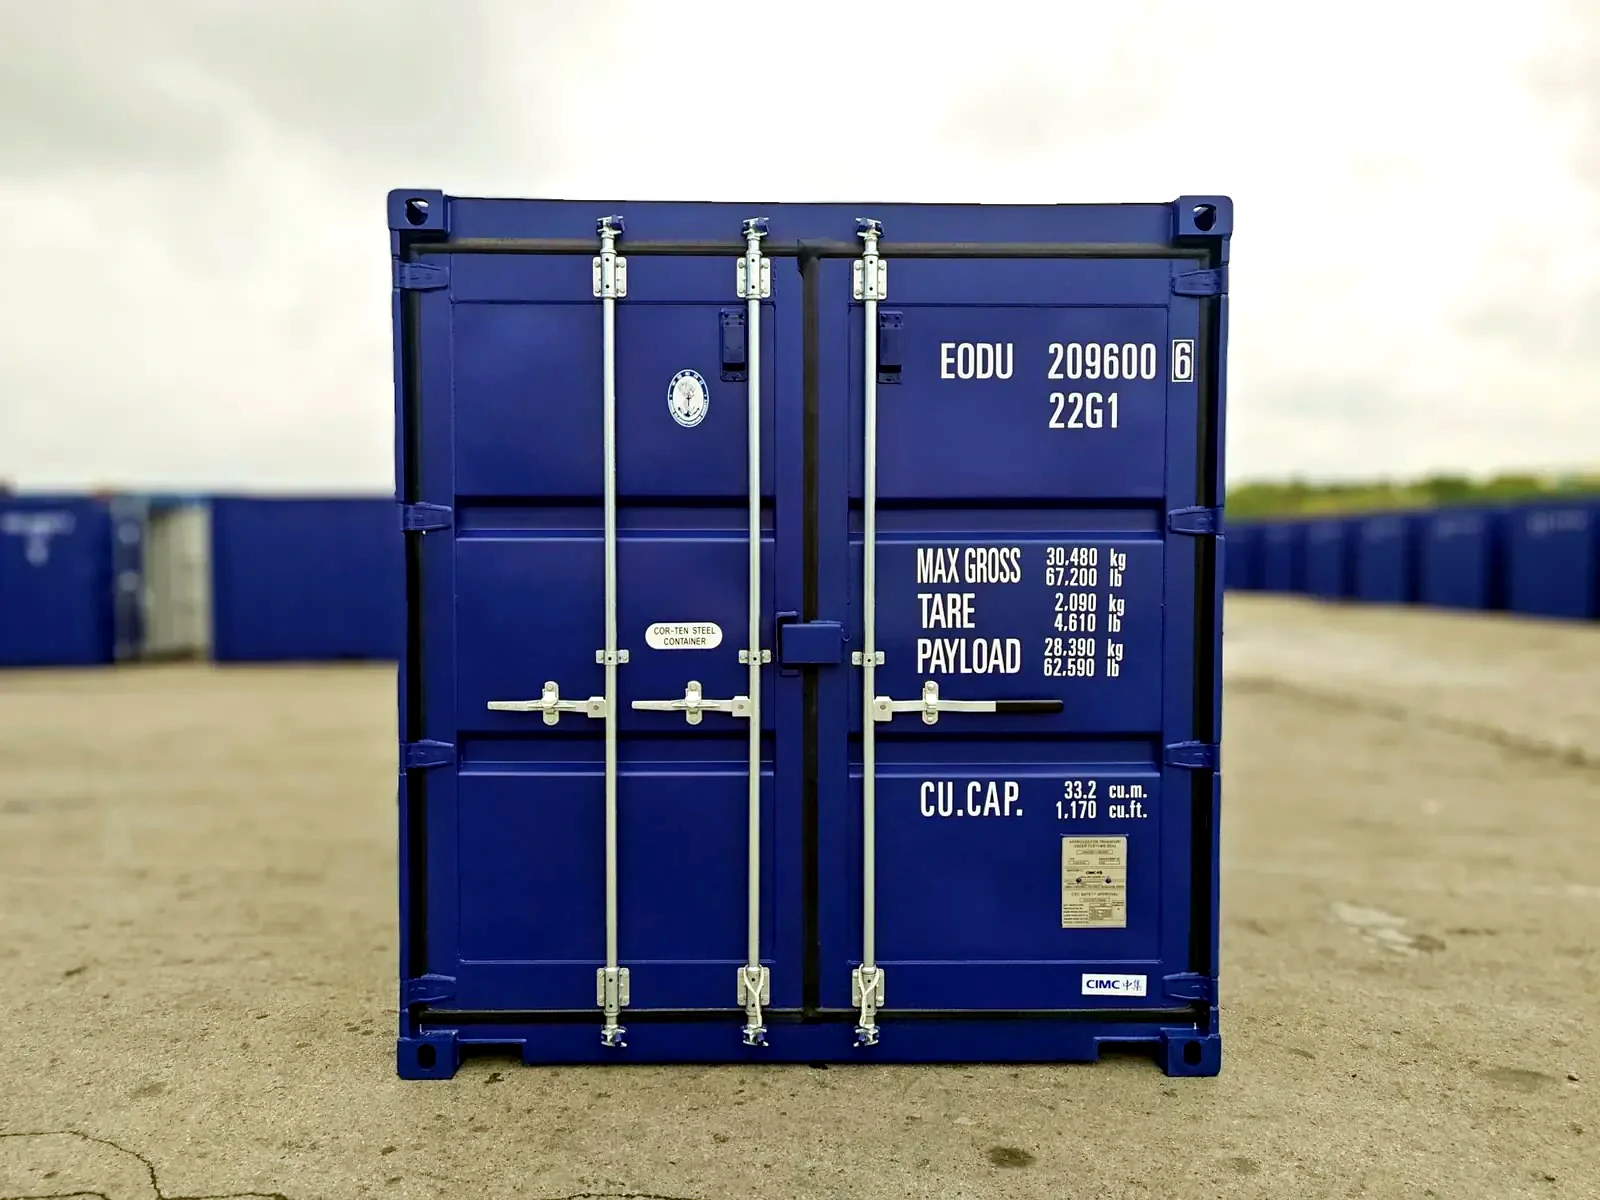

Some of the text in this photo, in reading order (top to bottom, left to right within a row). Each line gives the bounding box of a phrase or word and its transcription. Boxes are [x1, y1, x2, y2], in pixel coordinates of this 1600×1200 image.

[940, 342, 1191, 380] EODU 209600 6
[1048, 392, 1118, 429] 22G1
[917, 547, 1021, 584] MAX GROSS
[1046, 547, 1127, 571] 30,480 kg
[1045, 567, 1123, 587] 67,200 lb
[917, 592, 976, 629] TARE
[1054, 592, 1125, 617] 2,090 kg
[653, 626, 716, 635] COR-TEN STEEL
[1053, 612, 1122, 632] 4,610 lb
[663, 637, 707, 646] CONTAINER
[1044, 637, 1124, 661] 28,390 kg
[917, 637, 1021, 674] PAYLOAD
[1043, 657, 1120, 677] 62,590 lb
[920, 781, 1023, 817] CU.CAP.
[1064, 780, 1148, 799] 33.2 cu.m.
[1056, 799, 1148, 819] 1,170 cu.ft.
[1086, 979, 1121, 989] CIMC
